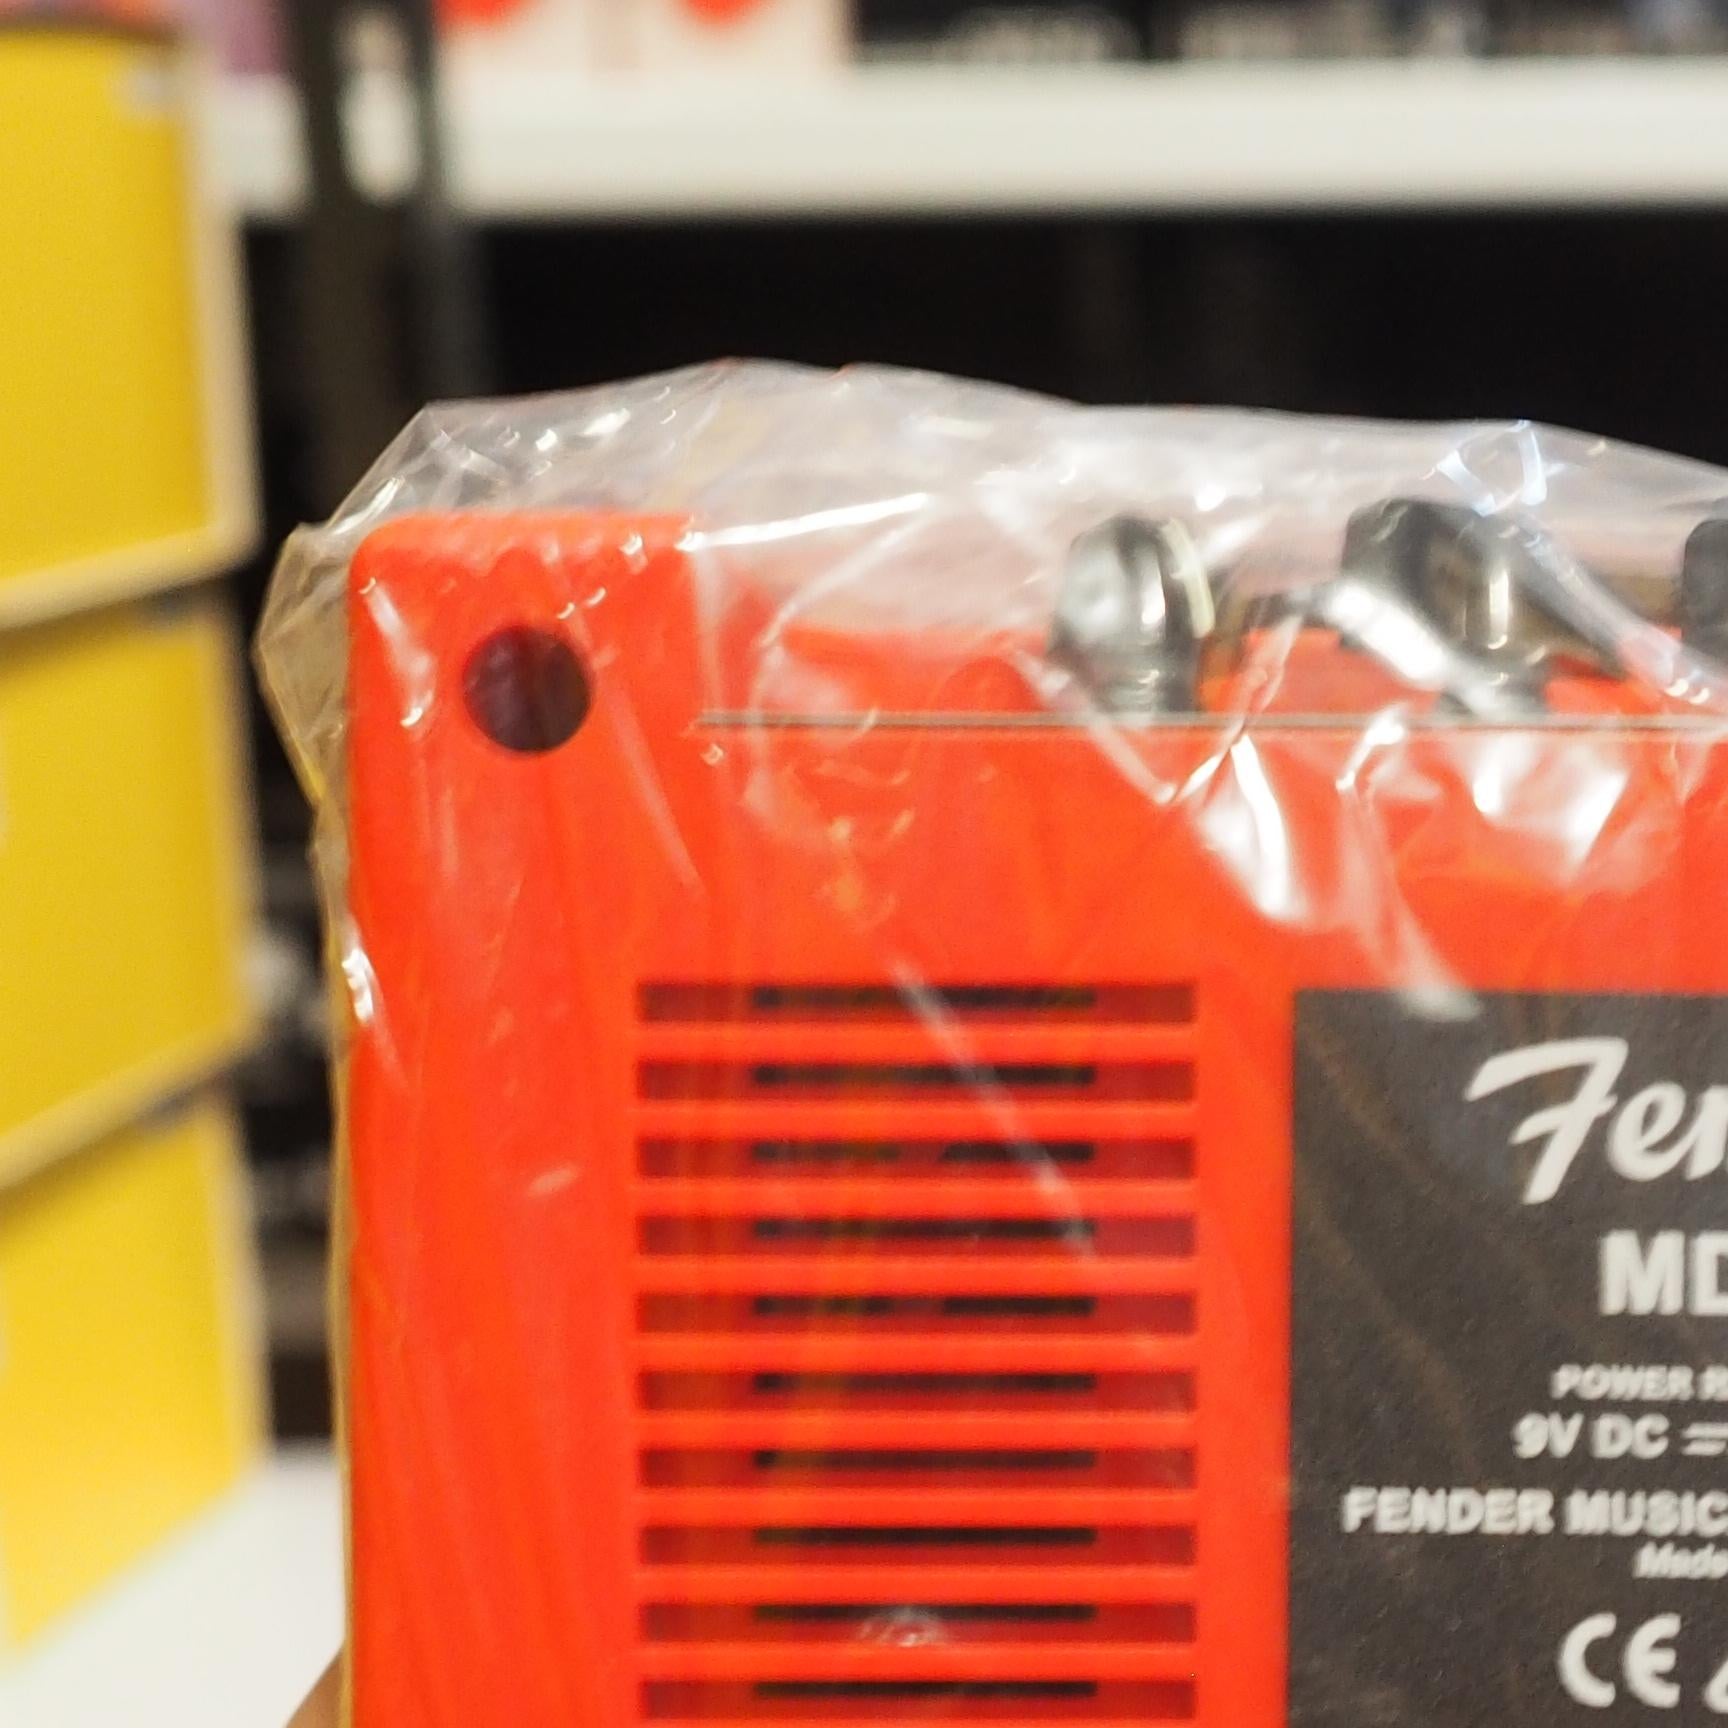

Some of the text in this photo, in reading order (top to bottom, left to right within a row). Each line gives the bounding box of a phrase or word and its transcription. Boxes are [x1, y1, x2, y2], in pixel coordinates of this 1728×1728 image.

[1551, 1363, 1693, 1402] POWER
[1512, 1412, 1584, 1460] 9V
[1591, 1413, 1670, 1460] DC
[1341, 1487, 1555, 1535] FENDER
[1557, 1612, 1681, 1709] CE
